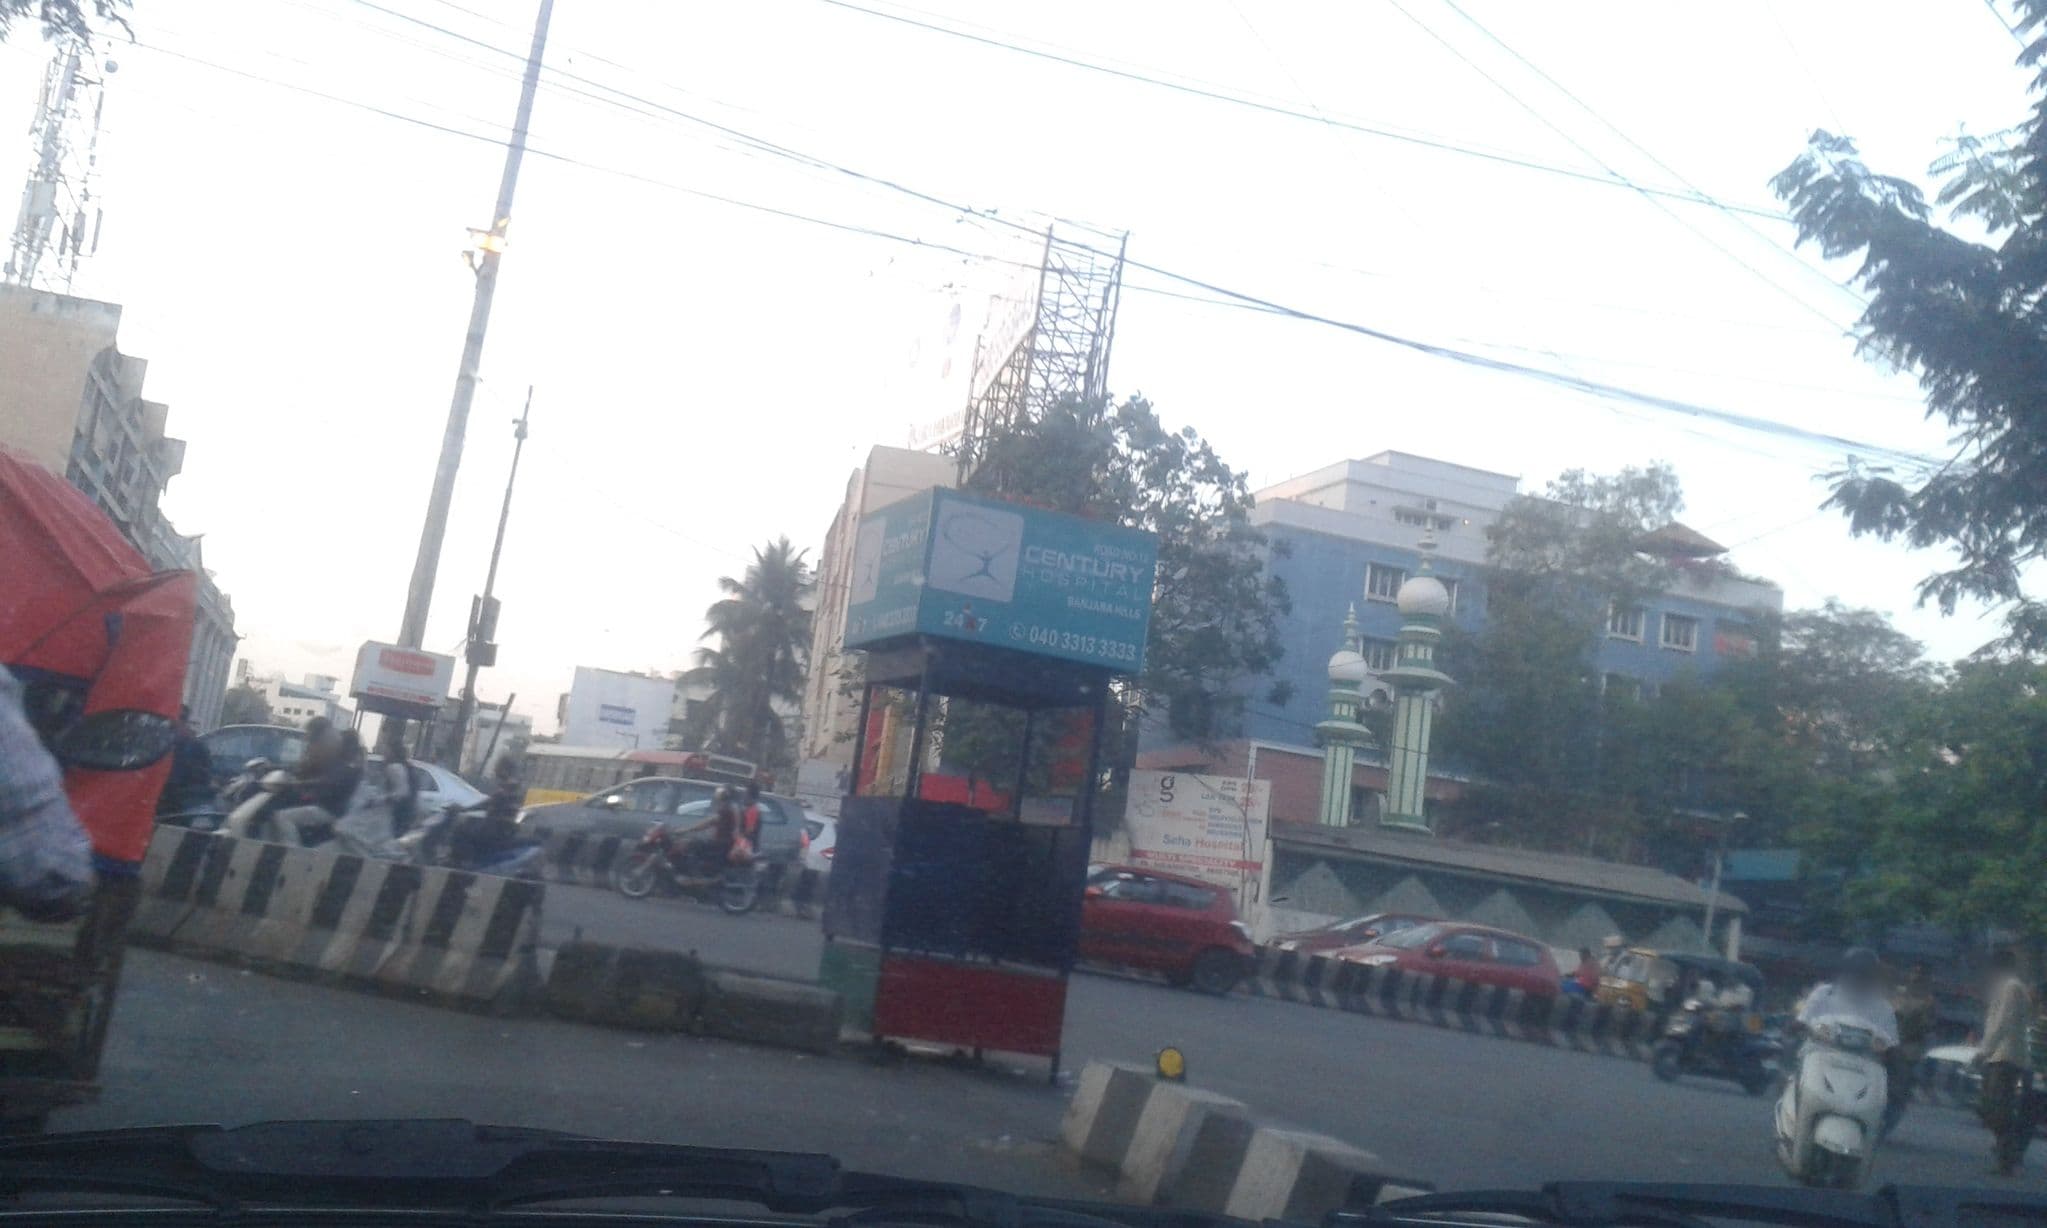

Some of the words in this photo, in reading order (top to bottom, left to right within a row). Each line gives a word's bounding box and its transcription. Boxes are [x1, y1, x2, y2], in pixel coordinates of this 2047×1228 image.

[1024, 545, 1144, 584] CENTURY
[1022, 566, 1143, 600] HOSPITAL
[1067, 596, 1113, 615] BANJARA
[1114, 606, 1142, 620] HILLS
[1030, 625, 1058, 646] 040
[1061, 631, 1096, 655] 3313
[1098, 639, 1137, 661] 3333
